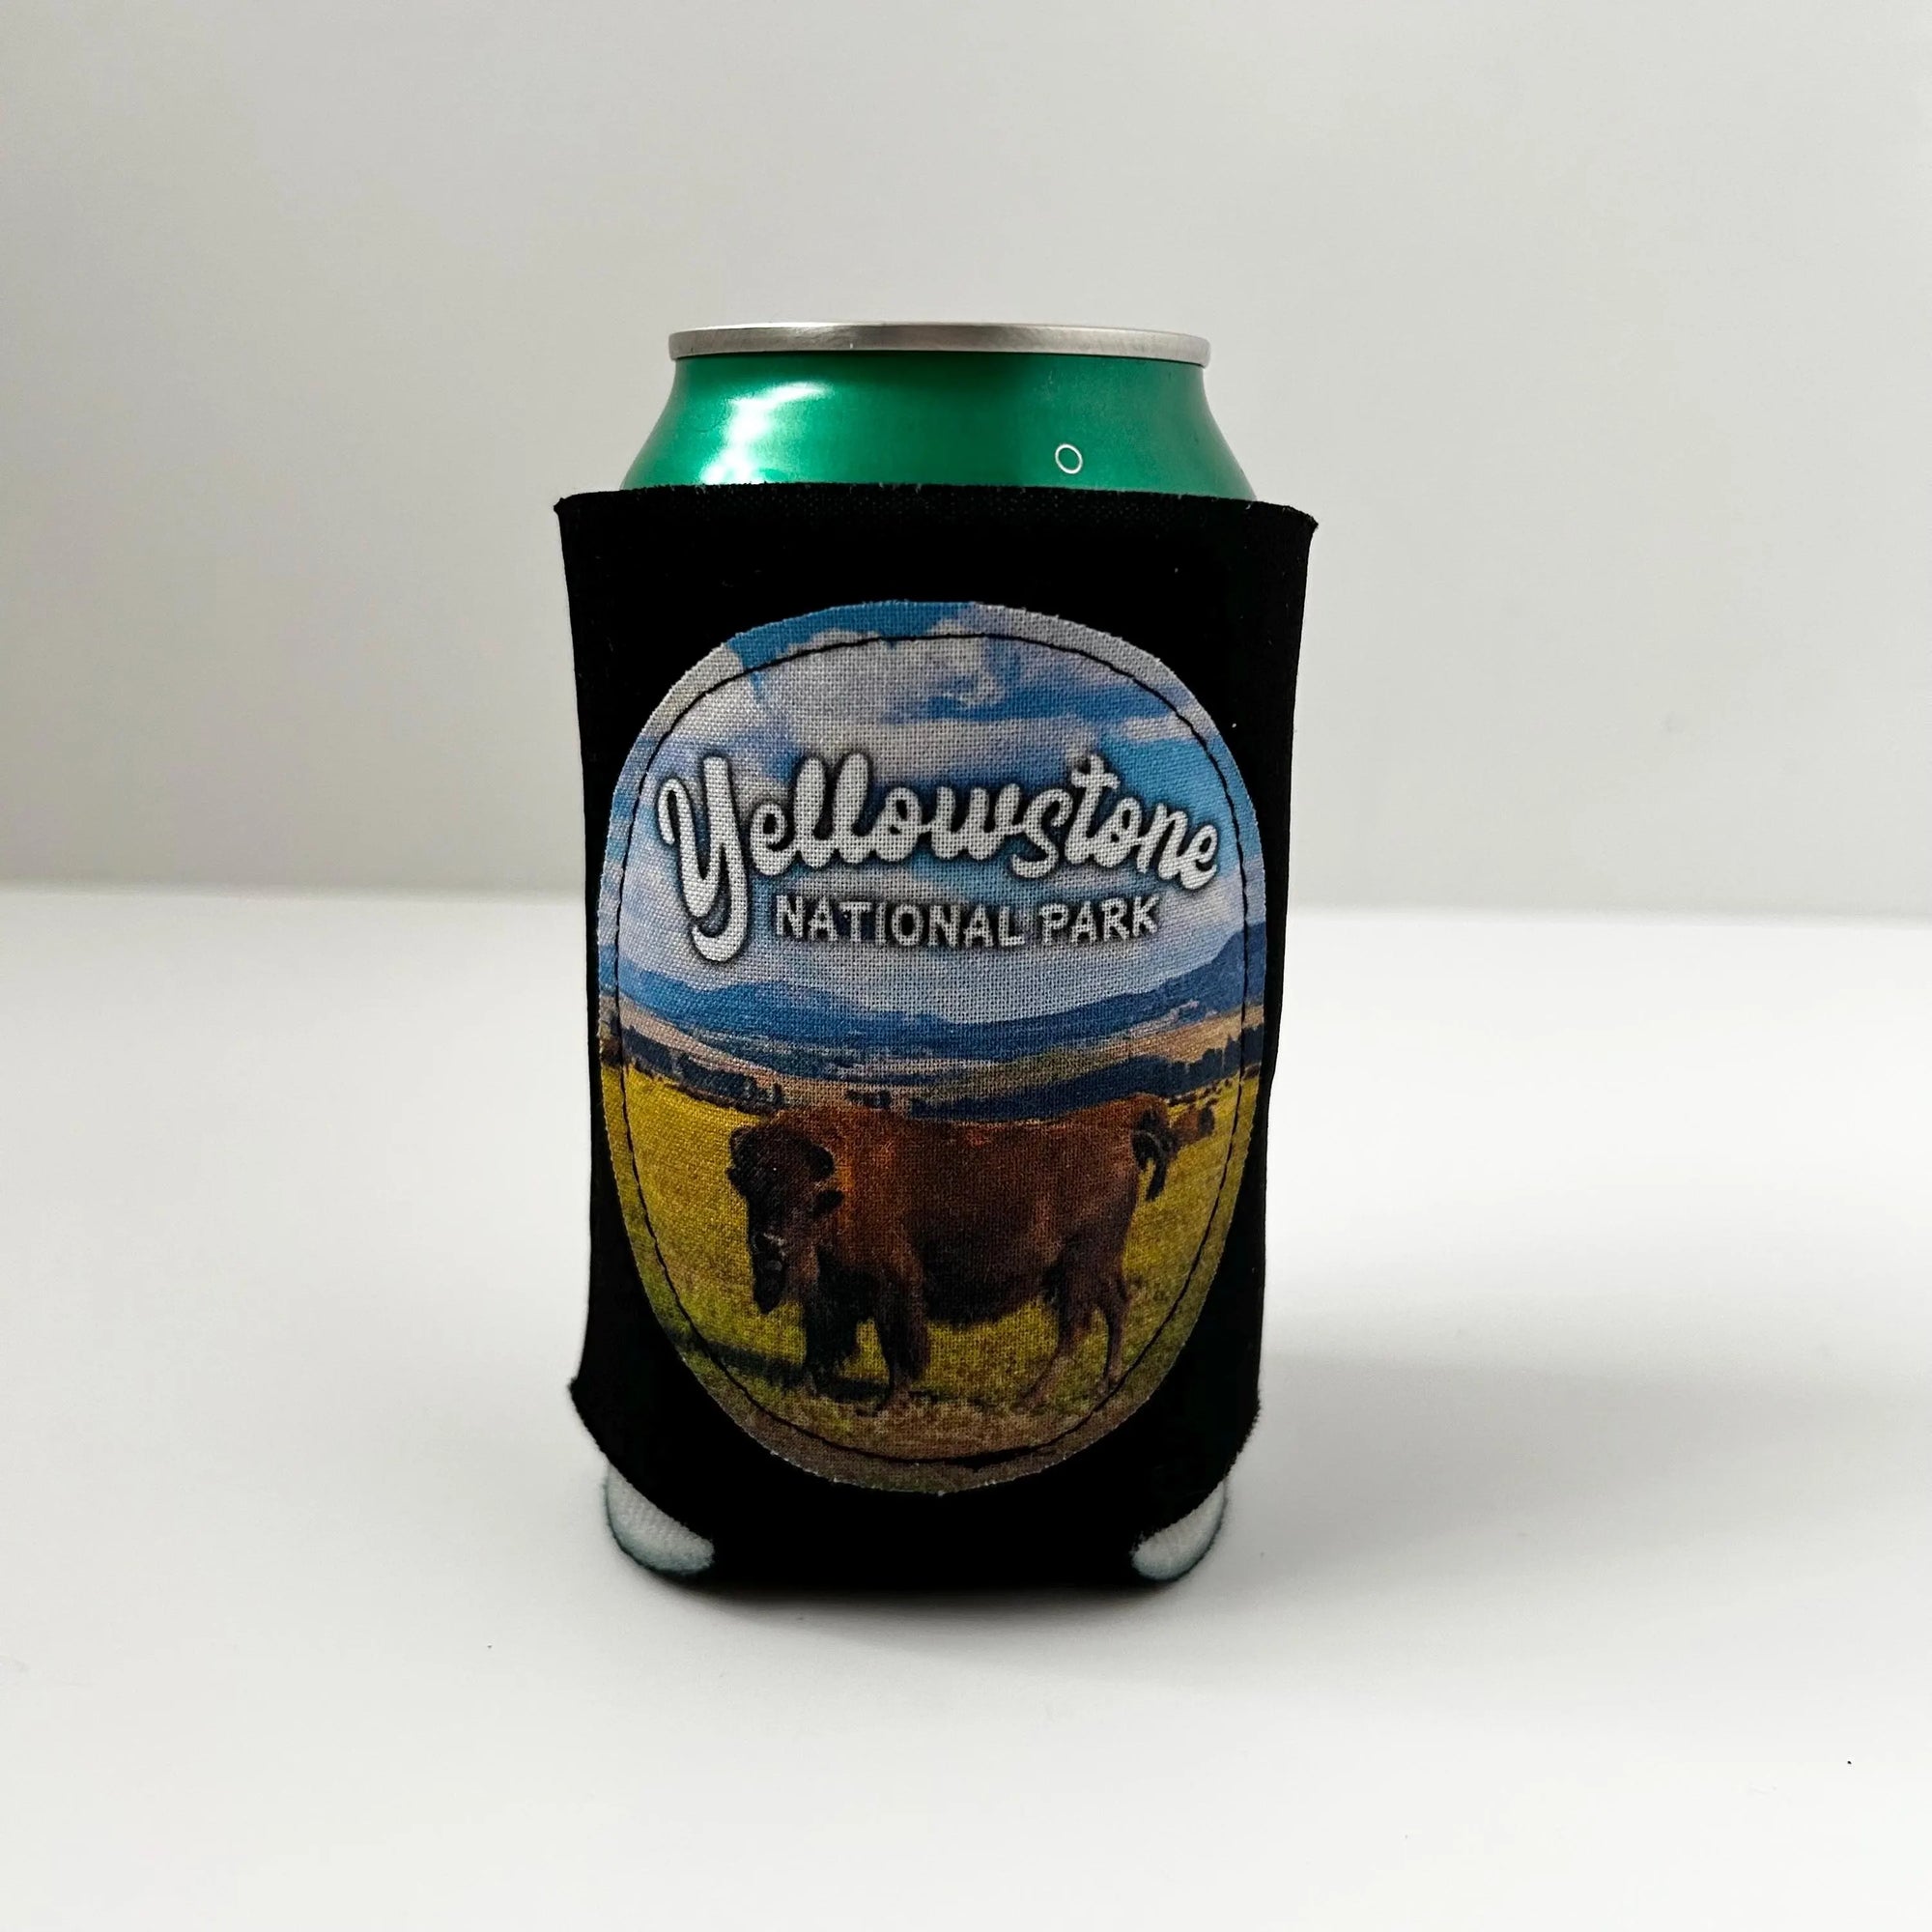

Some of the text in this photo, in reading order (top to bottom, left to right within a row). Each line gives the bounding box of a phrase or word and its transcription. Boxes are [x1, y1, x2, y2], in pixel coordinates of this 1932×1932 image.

[657, 752, 1219, 962] Yellowstone
[774, 895, 1160, 949] NATIONAL PARK
